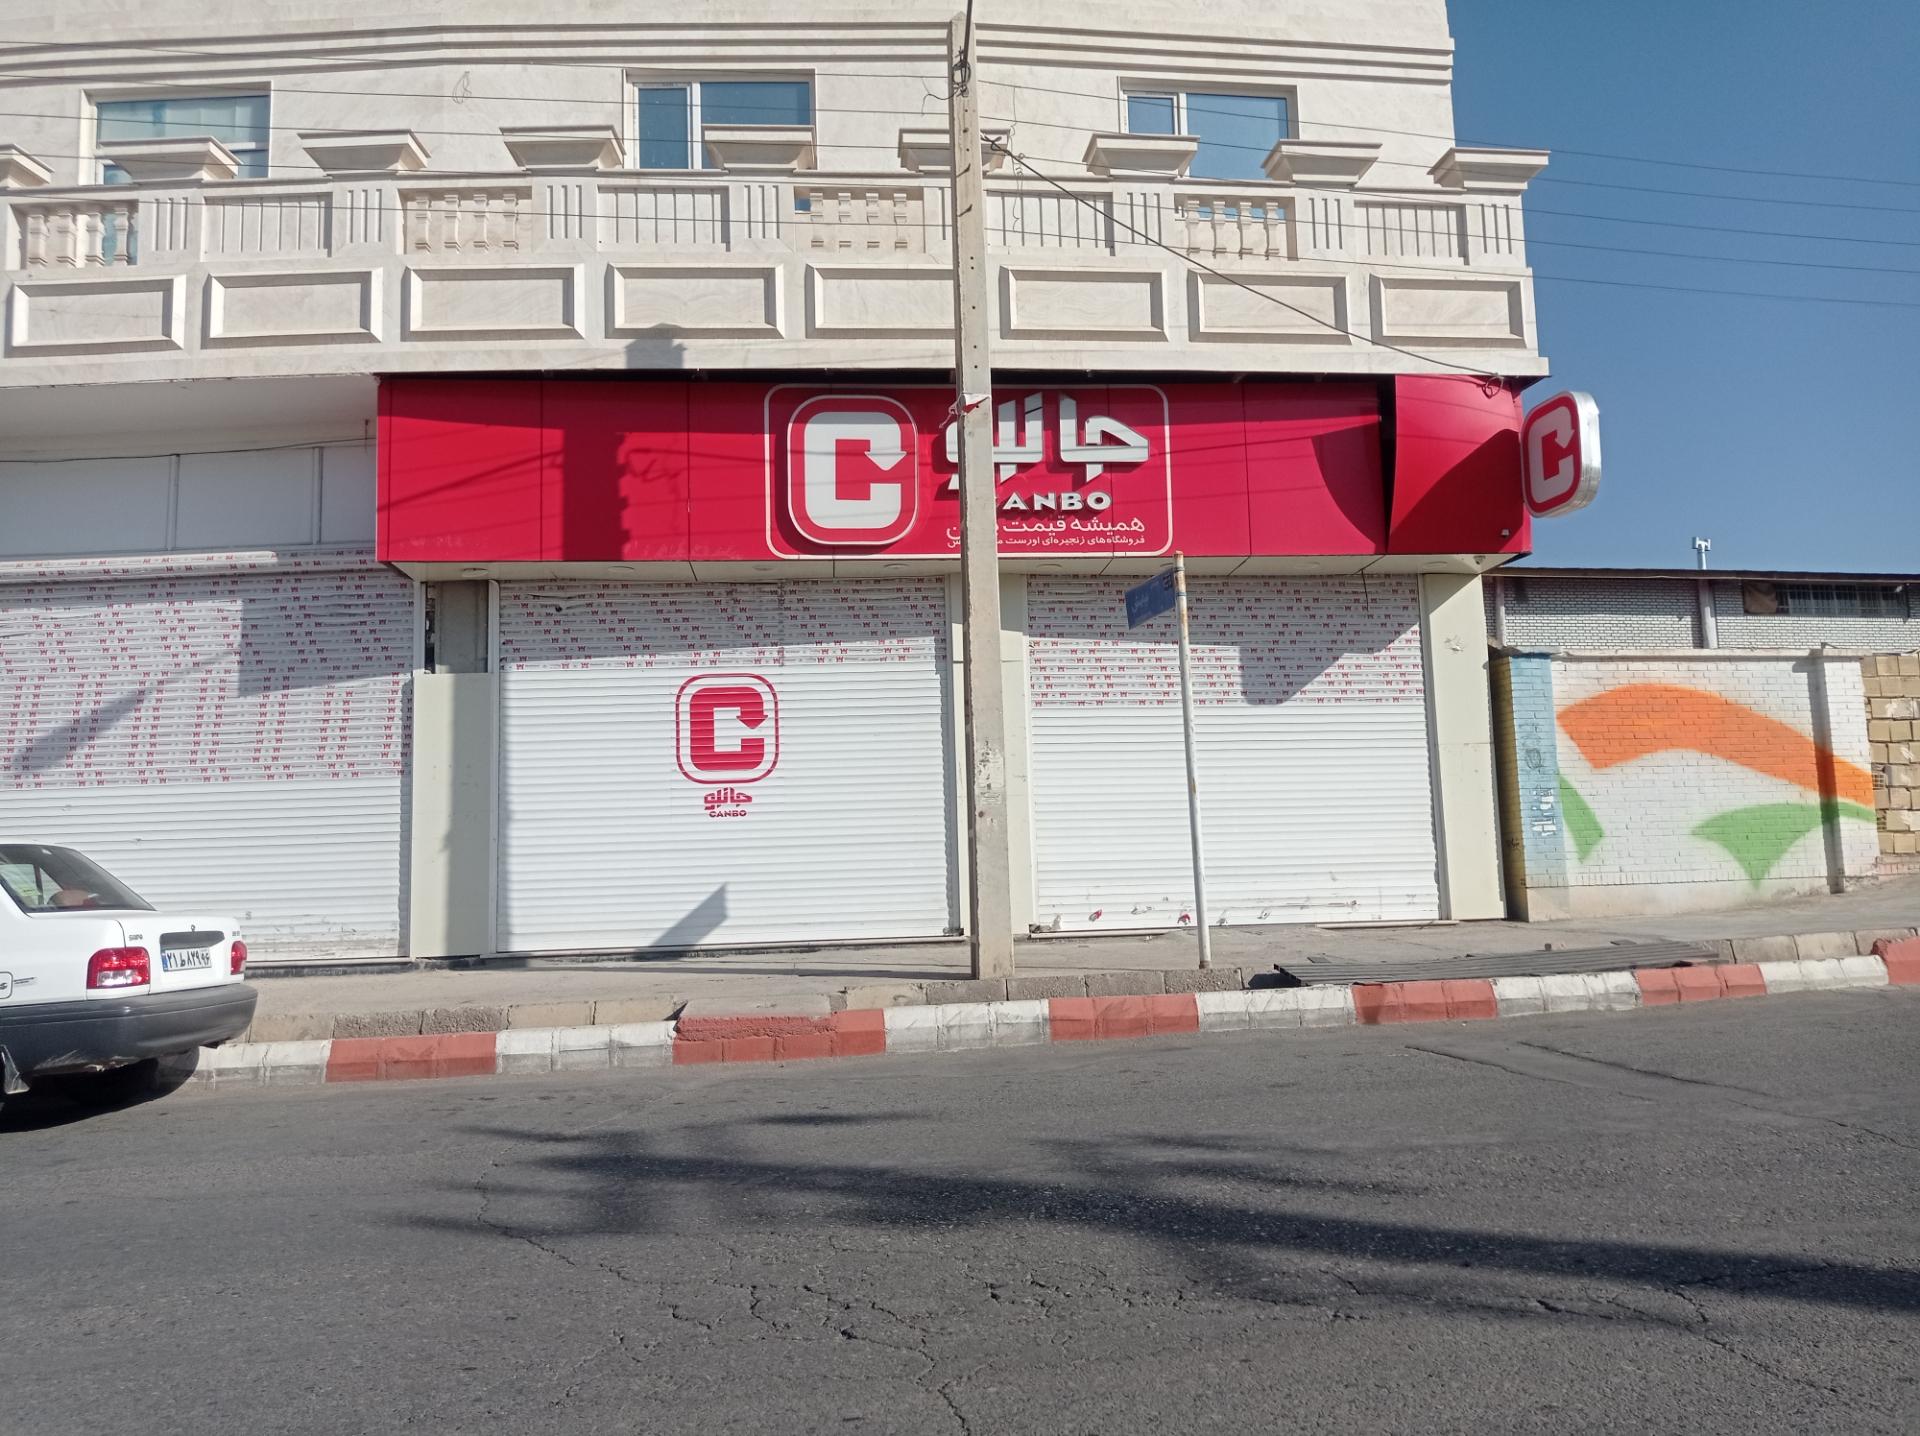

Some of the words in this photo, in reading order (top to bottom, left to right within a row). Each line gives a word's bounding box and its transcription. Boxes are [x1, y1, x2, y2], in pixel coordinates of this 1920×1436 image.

[805, 411, 907, 529] C
[1002, 491, 1112, 511] ANBO
[1002, 515, 1067, 536] قیمت
[1070, 517, 1145, 536] همیشه
[689, 686, 768, 771] C
[709, 809, 748, 818] CANBO
